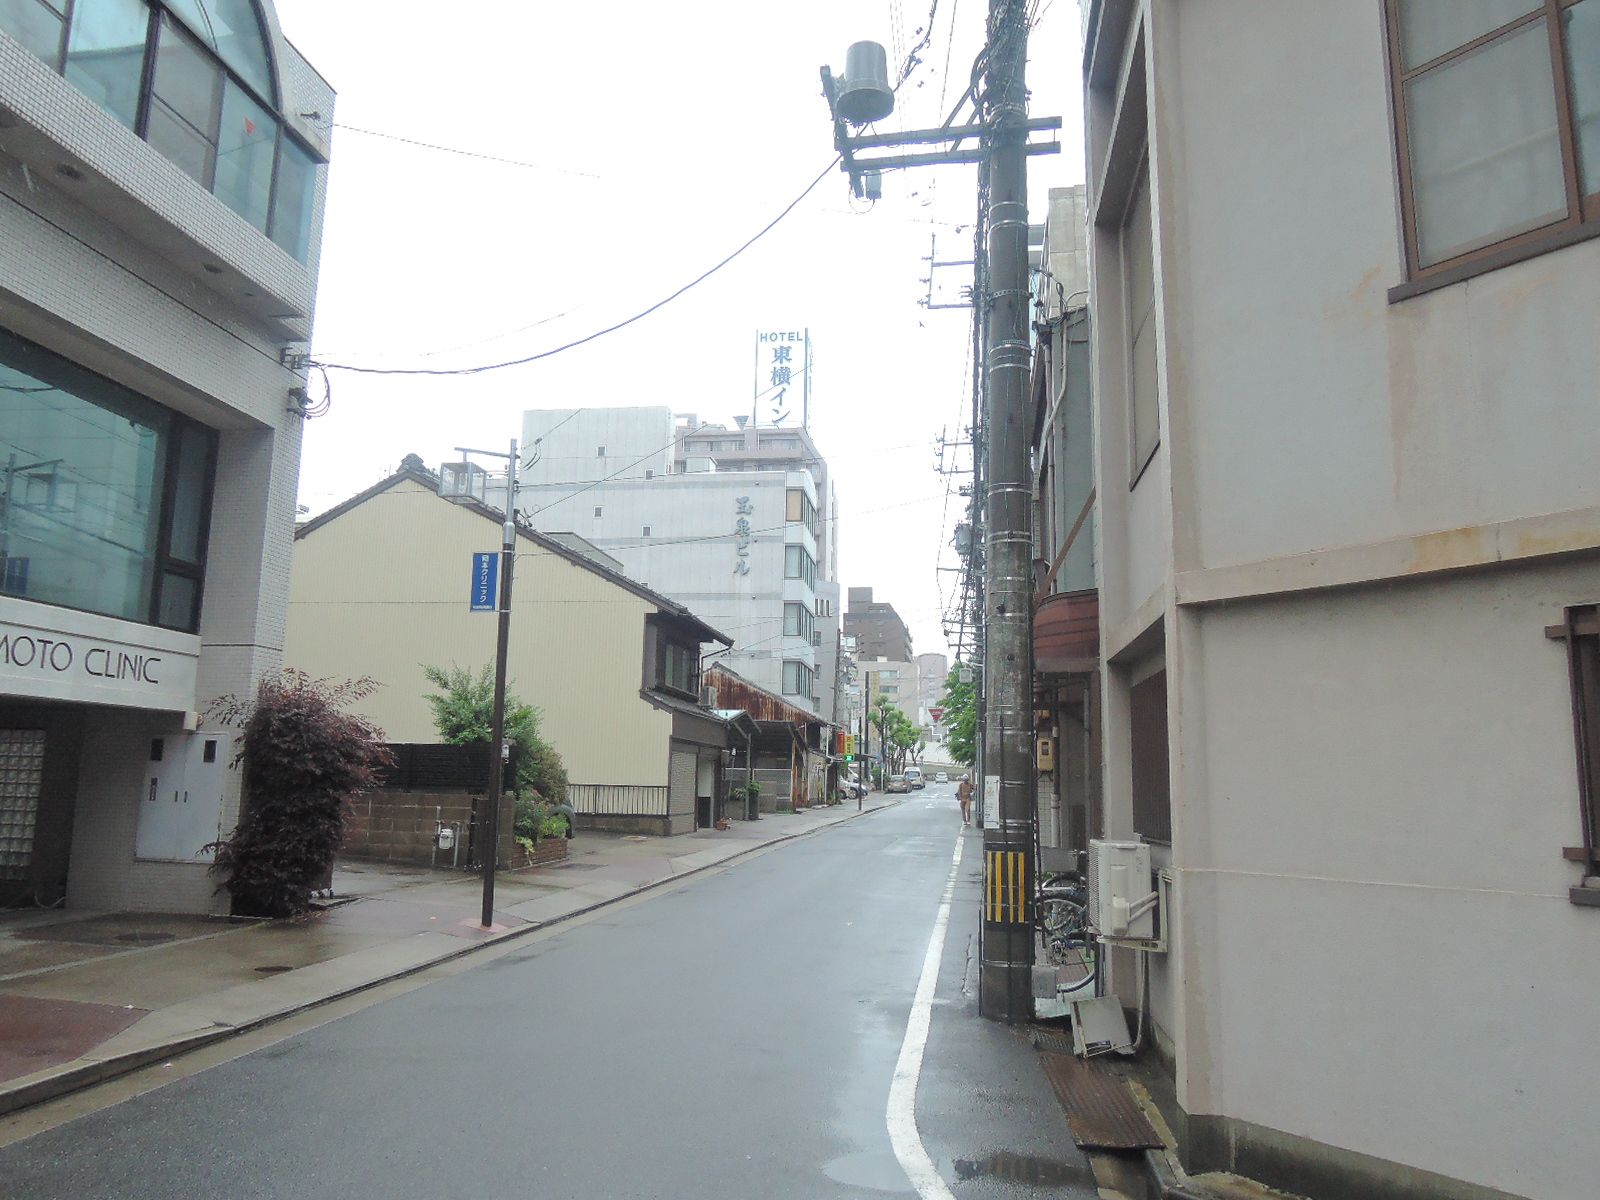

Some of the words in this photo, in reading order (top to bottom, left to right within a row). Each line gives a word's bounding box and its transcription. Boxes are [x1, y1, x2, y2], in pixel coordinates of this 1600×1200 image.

[760, 331, 803, 342] HOTEL
[770, 345, 793, 424] 東横イン
[85, 648, 162, 684] CLINIC
